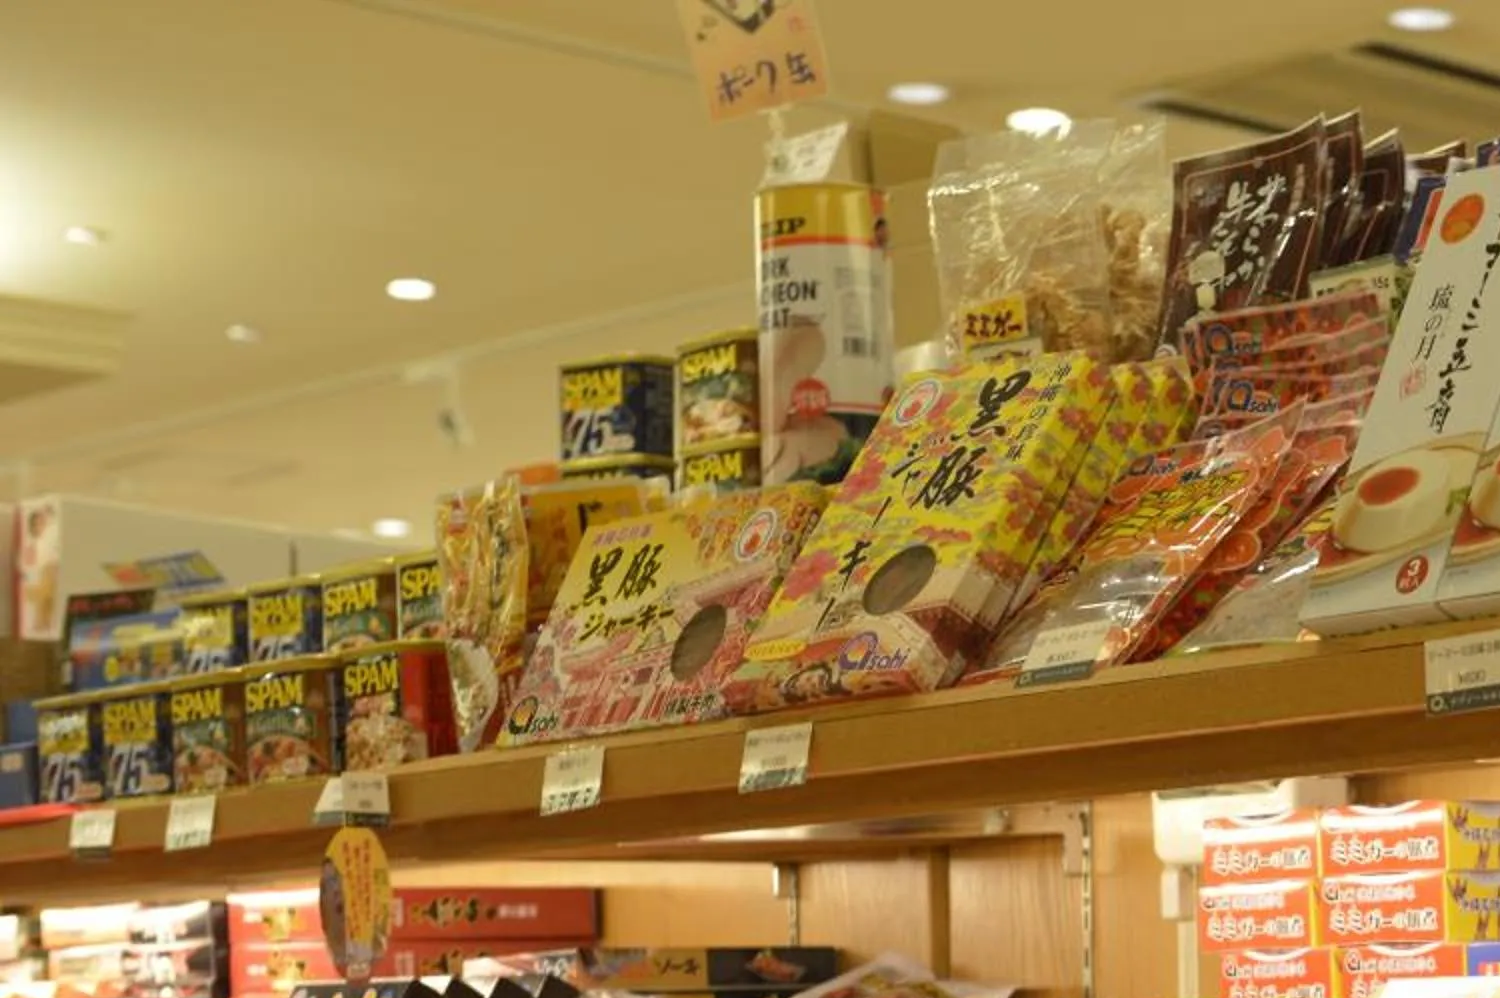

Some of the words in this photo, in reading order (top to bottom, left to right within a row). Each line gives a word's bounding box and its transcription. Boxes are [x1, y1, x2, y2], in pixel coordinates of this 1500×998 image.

[1415, 286, 1455, 361] 琉の月
[683, 345, 738, 378] SPAM
[909, 369, 1031, 511] 黒豚
[686, 452, 744, 483] SPAM
[325, 577, 379, 617] SPAM
[570, 544, 664, 612] 黒豚
[579, 604, 676, 643] ジャーキー
[246, 673, 303, 711] SPAM
[344, 655, 399, 698] SPAM
[172, 688, 223, 722] SPAM
